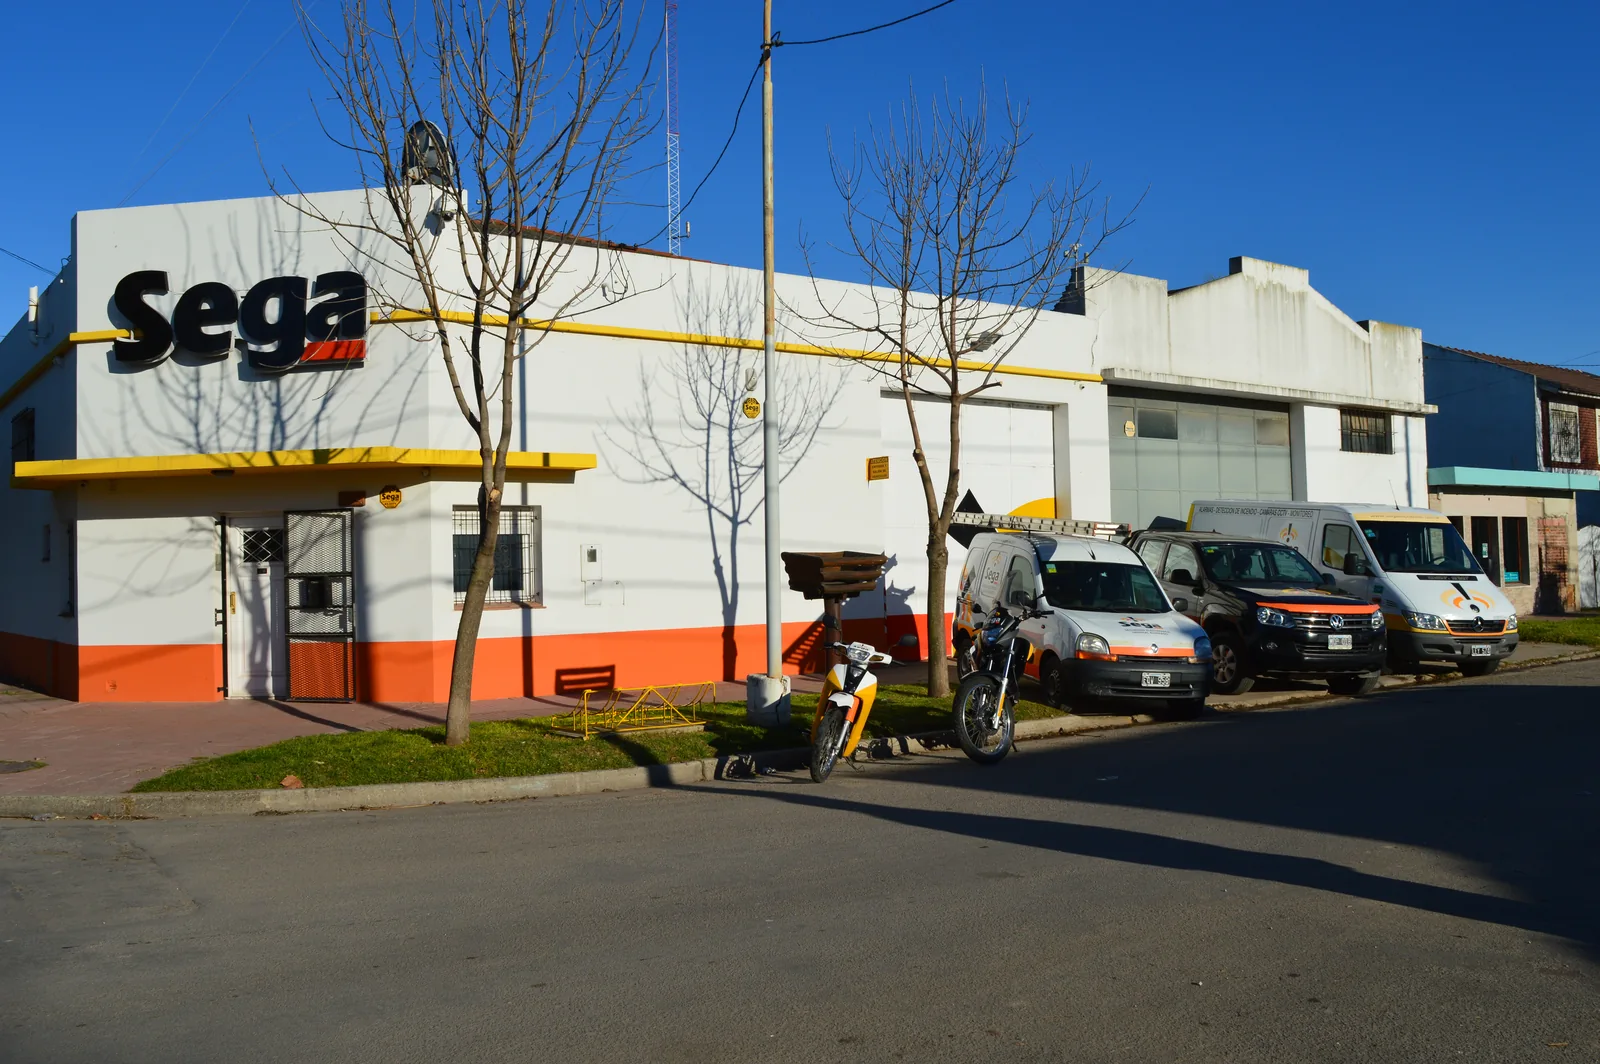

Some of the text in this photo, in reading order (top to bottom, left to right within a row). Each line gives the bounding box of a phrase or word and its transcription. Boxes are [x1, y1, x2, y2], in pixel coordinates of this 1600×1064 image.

[113, 270, 367, 369] Sega
[381, 493, 400, 502] Sega
[984, 567, 1000, 583] Sega
[1118, 621, 1164, 630] Sega
